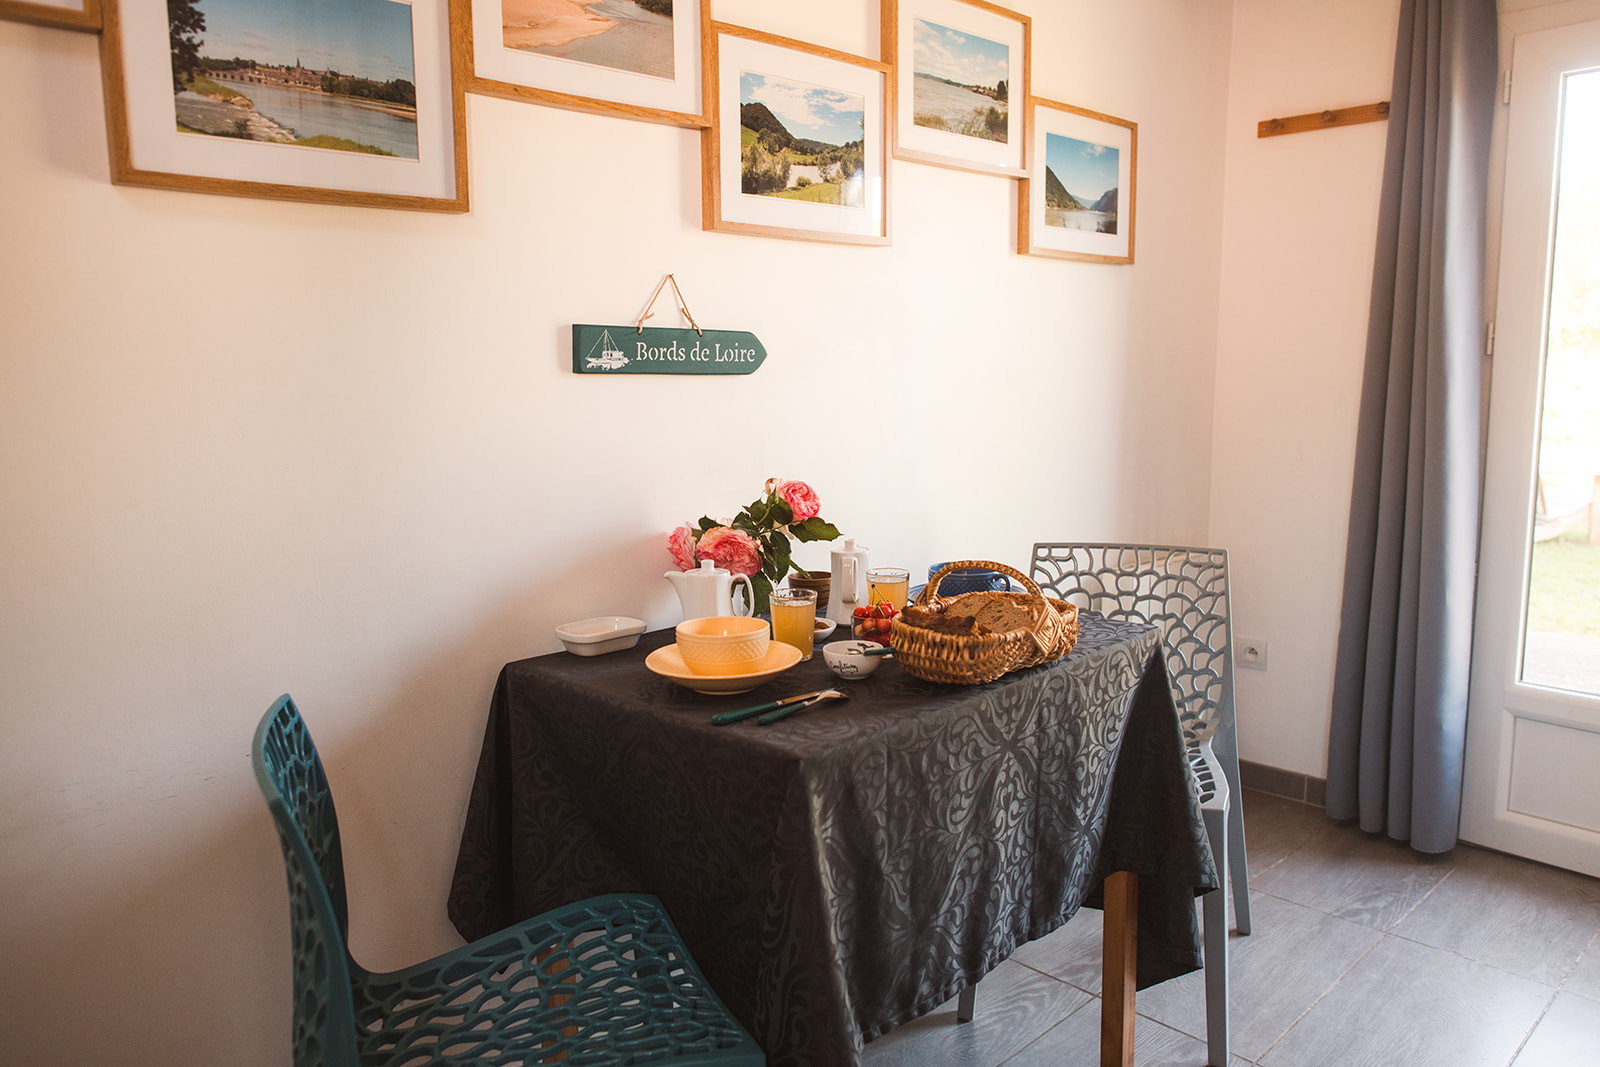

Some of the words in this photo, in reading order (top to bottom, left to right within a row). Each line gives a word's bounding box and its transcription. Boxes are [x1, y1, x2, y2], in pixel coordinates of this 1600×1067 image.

[636, 340, 686, 362] Bords
[690, 341, 710, 362] de
[715, 342, 756, 363] Loire
